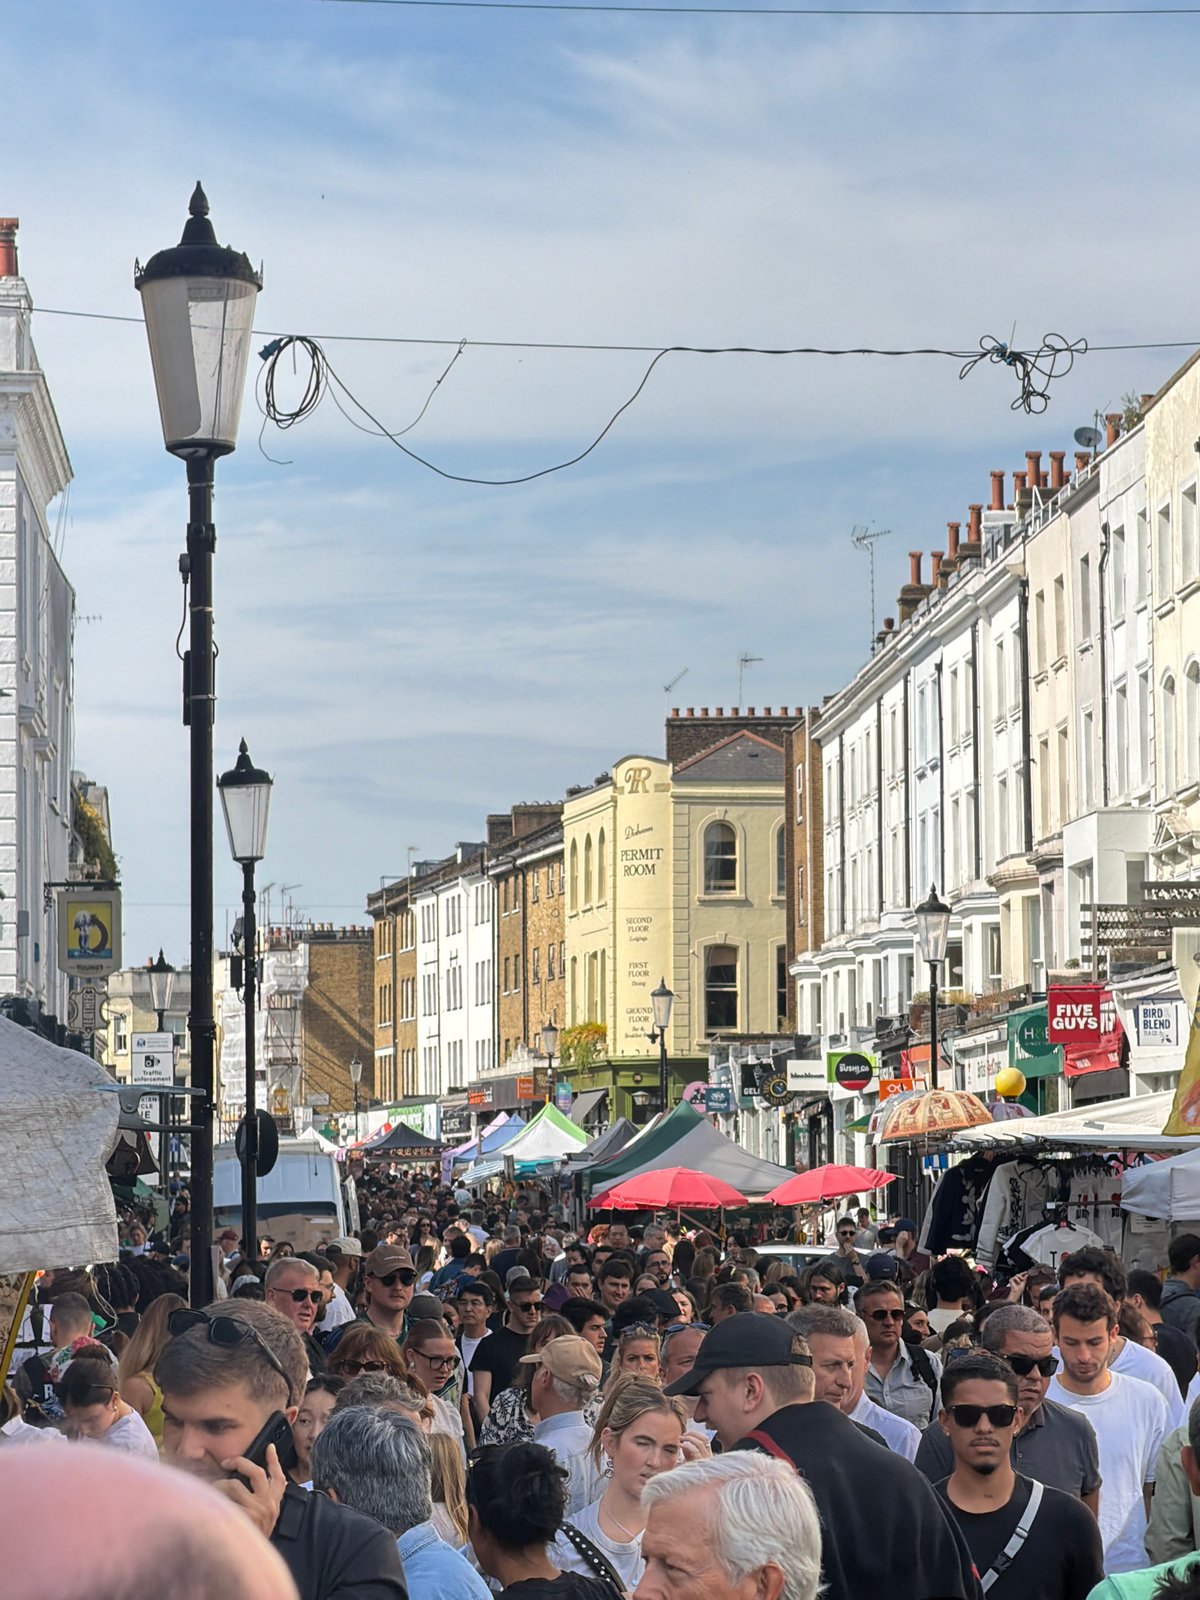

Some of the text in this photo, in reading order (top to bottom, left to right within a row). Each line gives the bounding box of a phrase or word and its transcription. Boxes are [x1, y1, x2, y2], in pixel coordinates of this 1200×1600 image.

[620, 848, 664, 862] PERMIT
[623, 863, 656, 877] ROOM
[625, 917, 652, 925] SECOND
[628, 925, 649, 933] FLOOR
[628, 969, 649, 977] FLOOR
[83, 993, 95, 1027] LEATHER
[626, 1007, 653, 1015] GROUND
[1056, 1004, 1094, 1017] FIVE
[1143, 1008, 1163, 1018] BIRD
[628, 1015, 649, 1023] FLOOR
[1052, 1017, 1098, 1030] GUYS
[1143, 1019, 1171, 1029] BLEND
[839, 1065, 859, 1073] SUSHI
